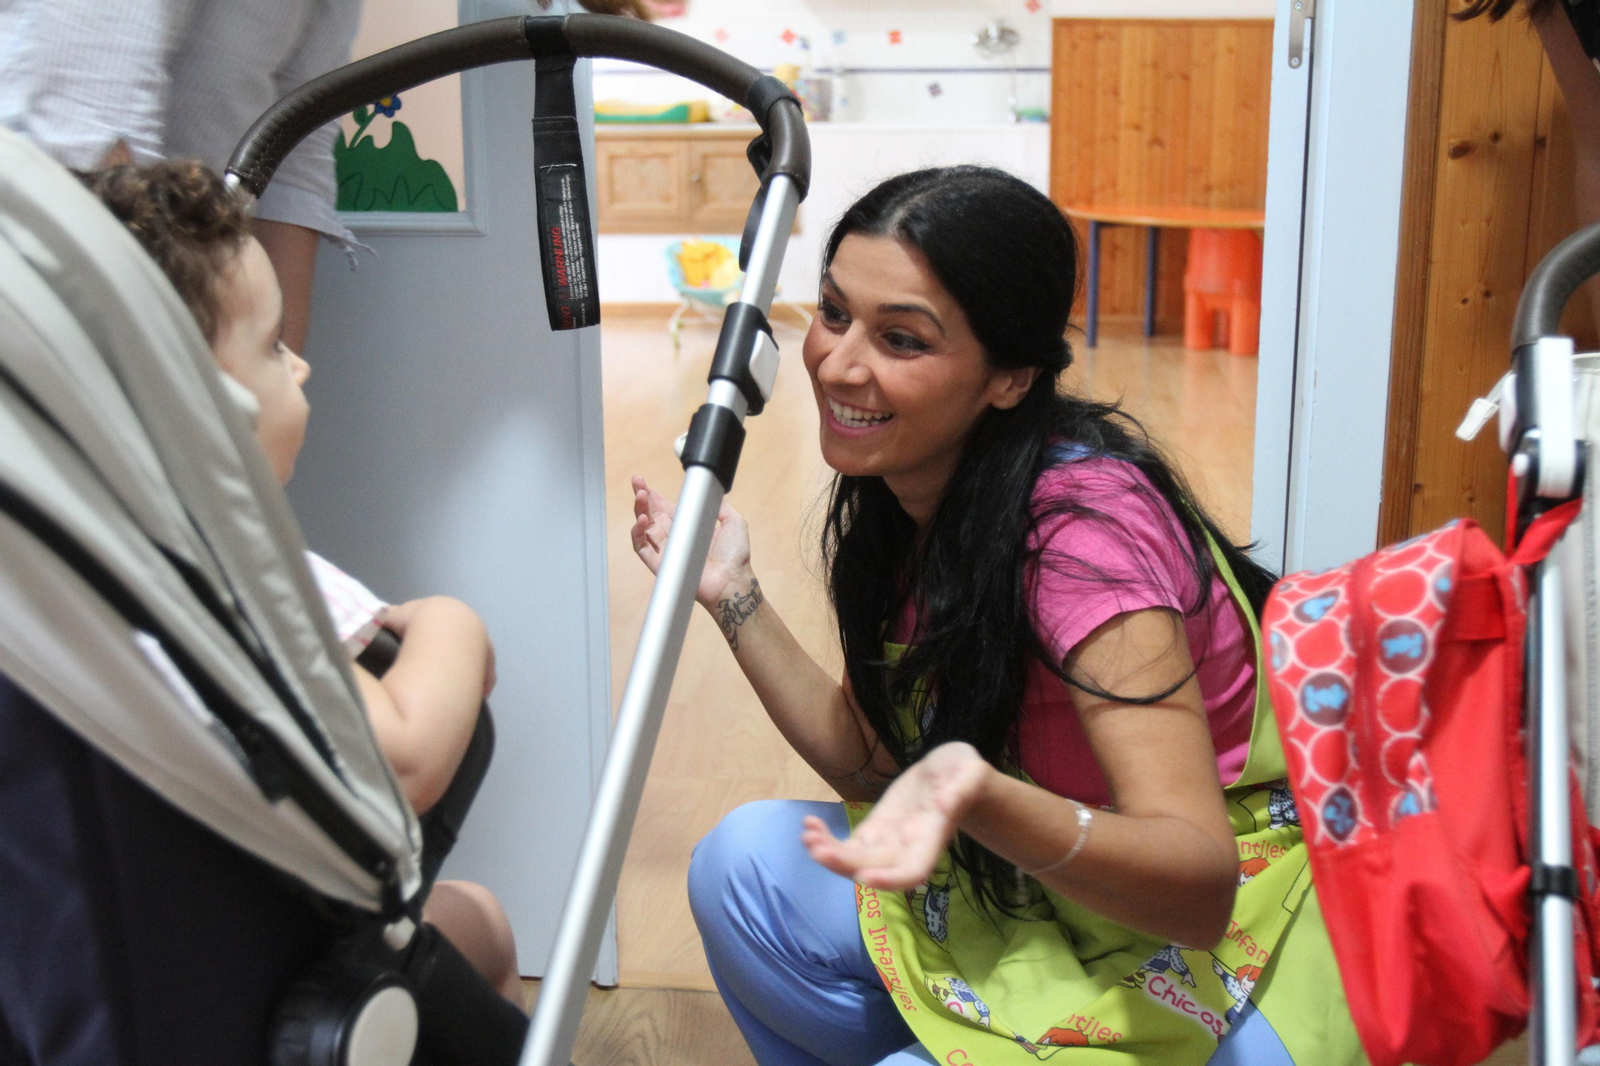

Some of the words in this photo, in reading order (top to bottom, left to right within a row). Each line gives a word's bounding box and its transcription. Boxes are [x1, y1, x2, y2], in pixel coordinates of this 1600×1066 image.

[552, 226, 568, 286] WARNUNG
[868, 924, 917, 1011] Infantiles
[1224, 920, 1269, 963] Infan
[1148, 976, 1223, 1034] Chicos
